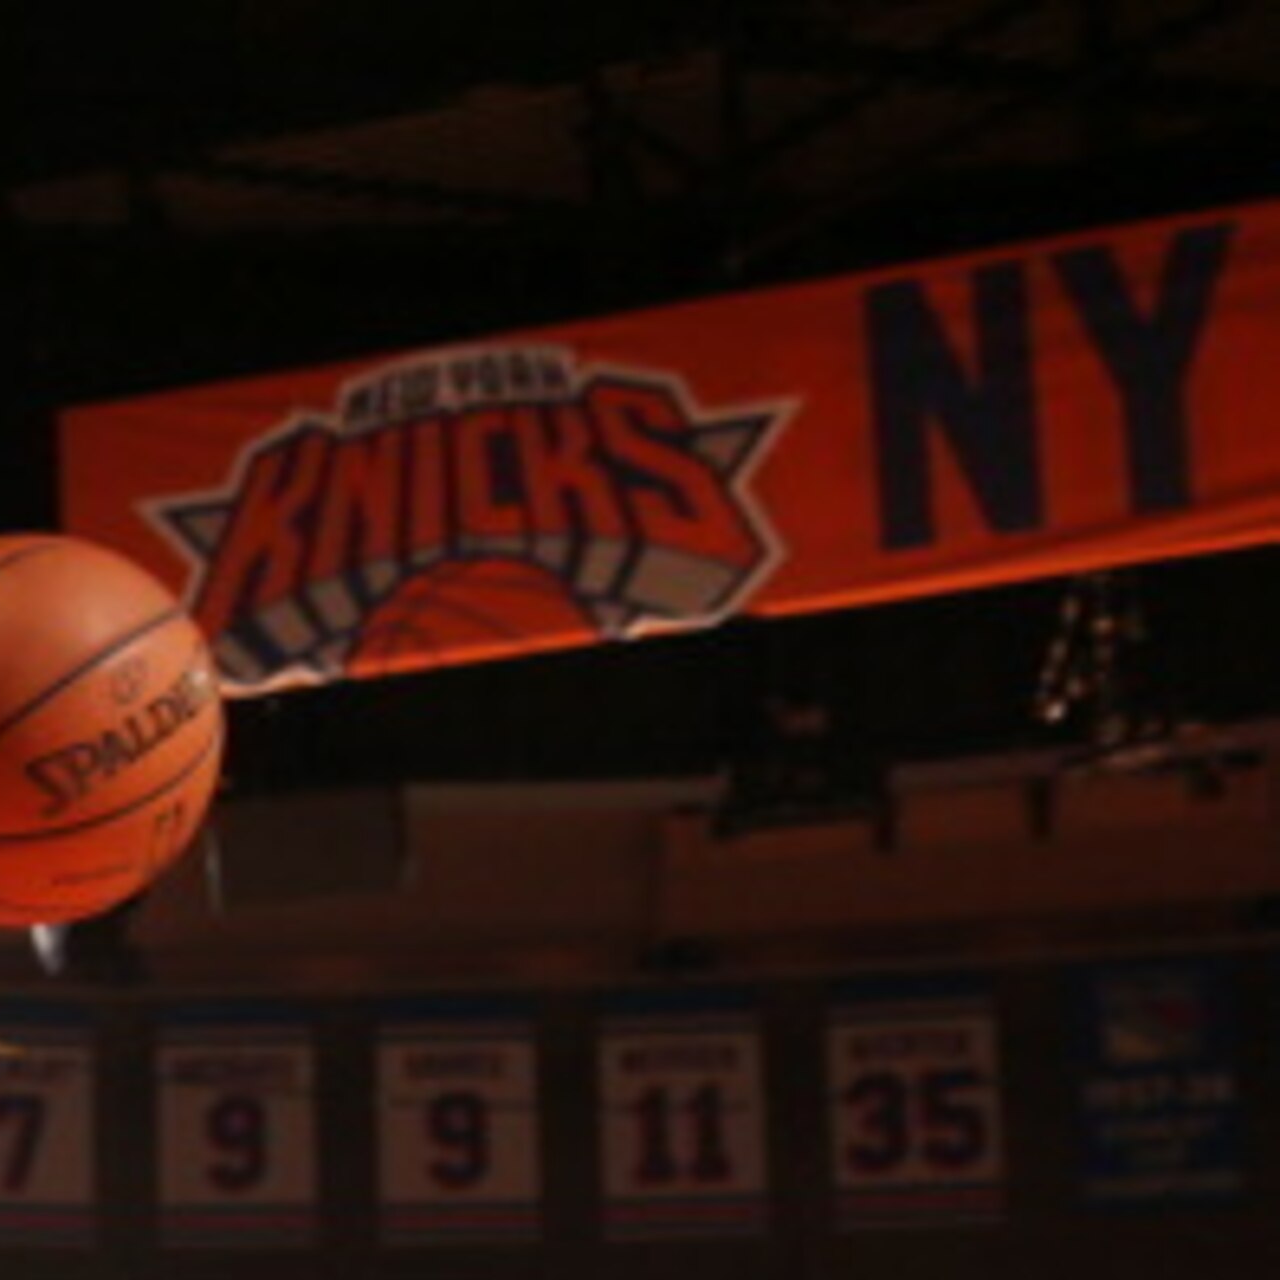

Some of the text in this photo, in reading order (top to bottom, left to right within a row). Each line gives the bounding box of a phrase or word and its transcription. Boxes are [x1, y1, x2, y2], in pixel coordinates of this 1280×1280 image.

[343, 350, 570, 424] NEW YORK
[862, 220, 1239, 553] NY
[192, 376, 760, 645] KNICKS
[24, 672, 212, 820] SPALDI
[203, 1091, 269, 1192] 9
[425, 1089, 491, 1191] 9
[633, 1078, 733, 1186] 11
[843, 1070, 992, 1174] 35
